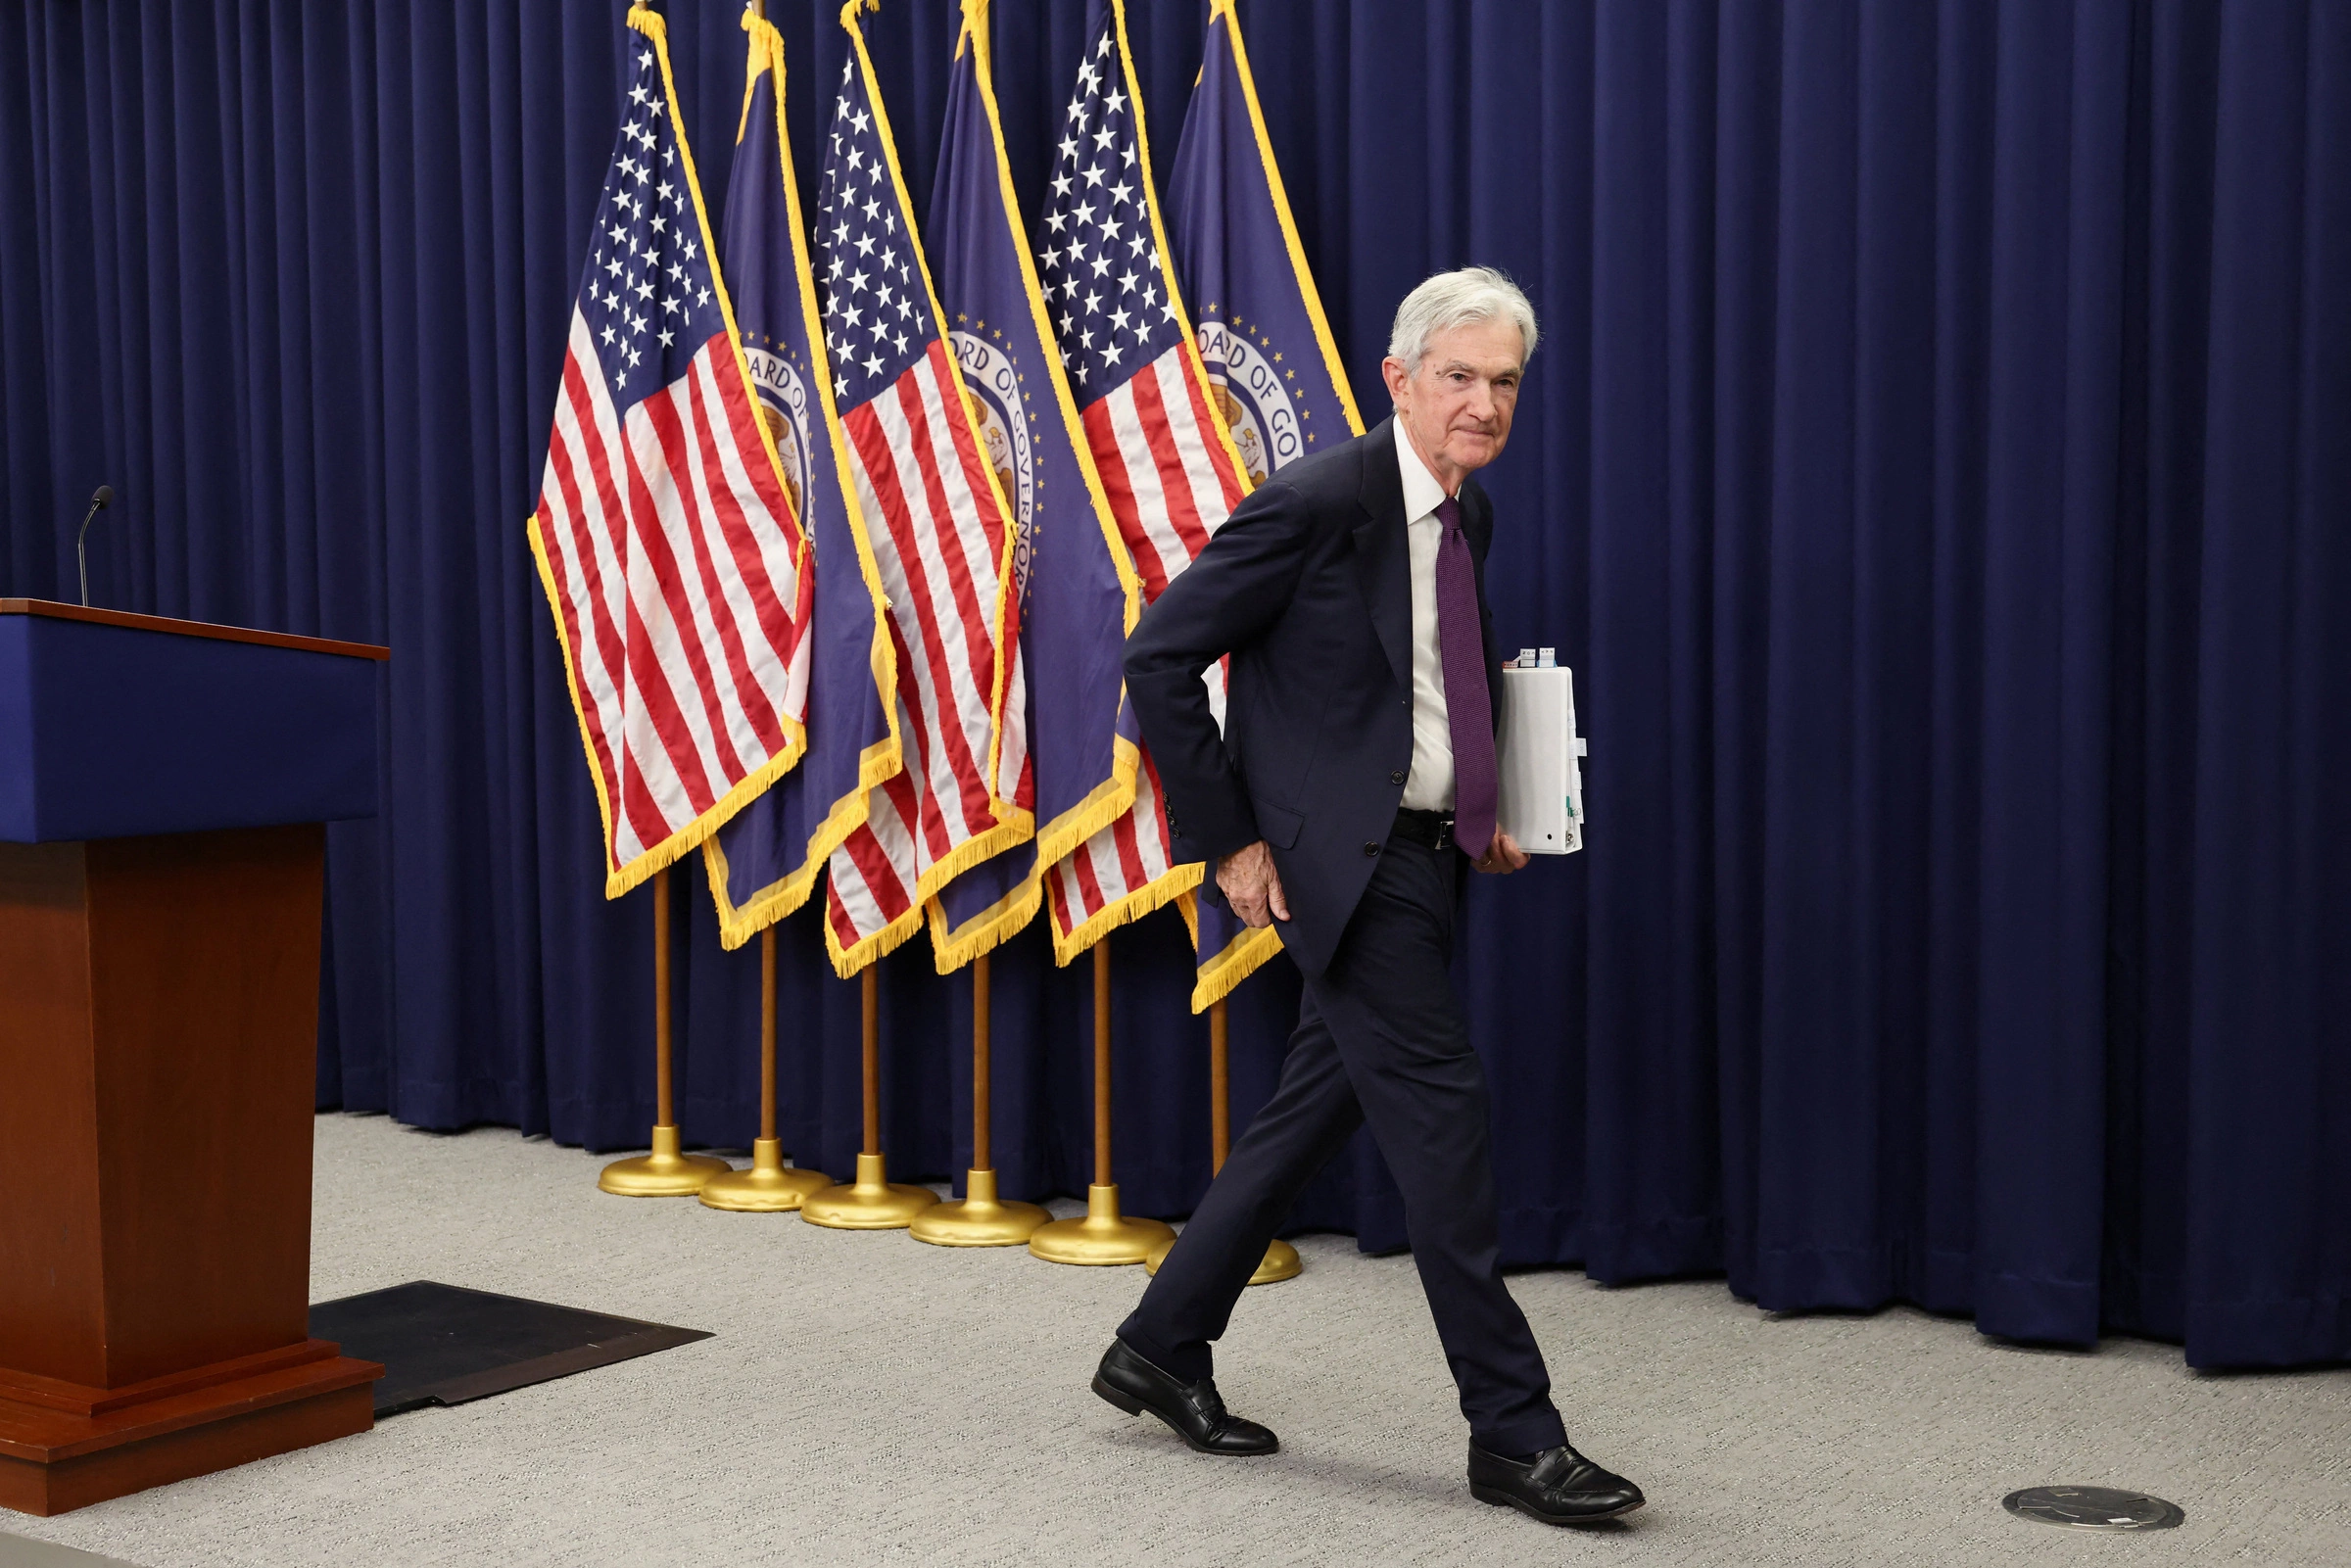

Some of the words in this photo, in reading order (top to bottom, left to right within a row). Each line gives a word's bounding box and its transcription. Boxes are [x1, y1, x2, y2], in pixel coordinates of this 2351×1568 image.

[1250, 364, 1278, 401] OF
[1271, 407, 1297, 457] GO
[1014, 409, 1031, 602] GOVERNOR
